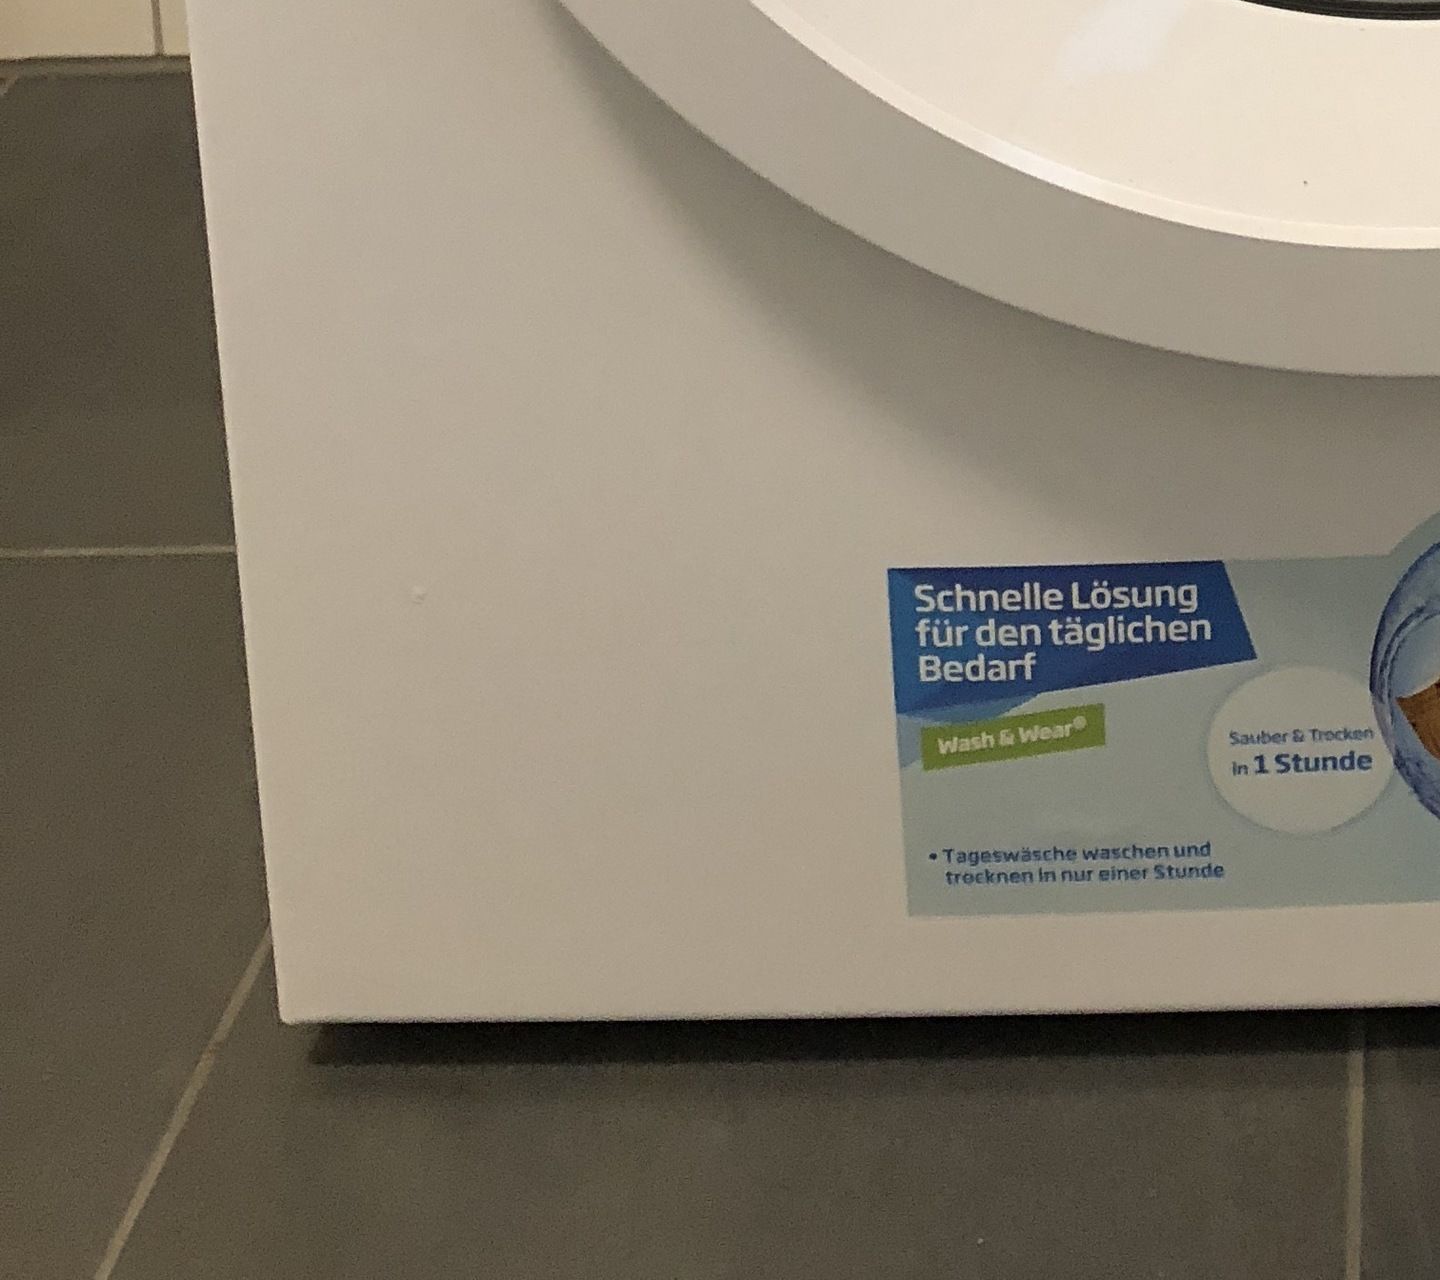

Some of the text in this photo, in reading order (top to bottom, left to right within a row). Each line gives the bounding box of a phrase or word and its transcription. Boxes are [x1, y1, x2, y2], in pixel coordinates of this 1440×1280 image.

[914, 579, 1199, 615] Schnelle Lösung
[915, 615, 1212, 652] für den täglichen
[918, 652, 1037, 682] Bedarf
[938, 731, 994, 755] Wash
[1000, 727, 1015, 746] &
[1228, 725, 1375, 746] Sauber & Trocken
[1232, 750, 1373, 776] in 1 Stunde
[942, 842, 1211, 867] Tageswäsche waschen und
[945, 863, 1225, 886] trocknen in nur einer Stunde
